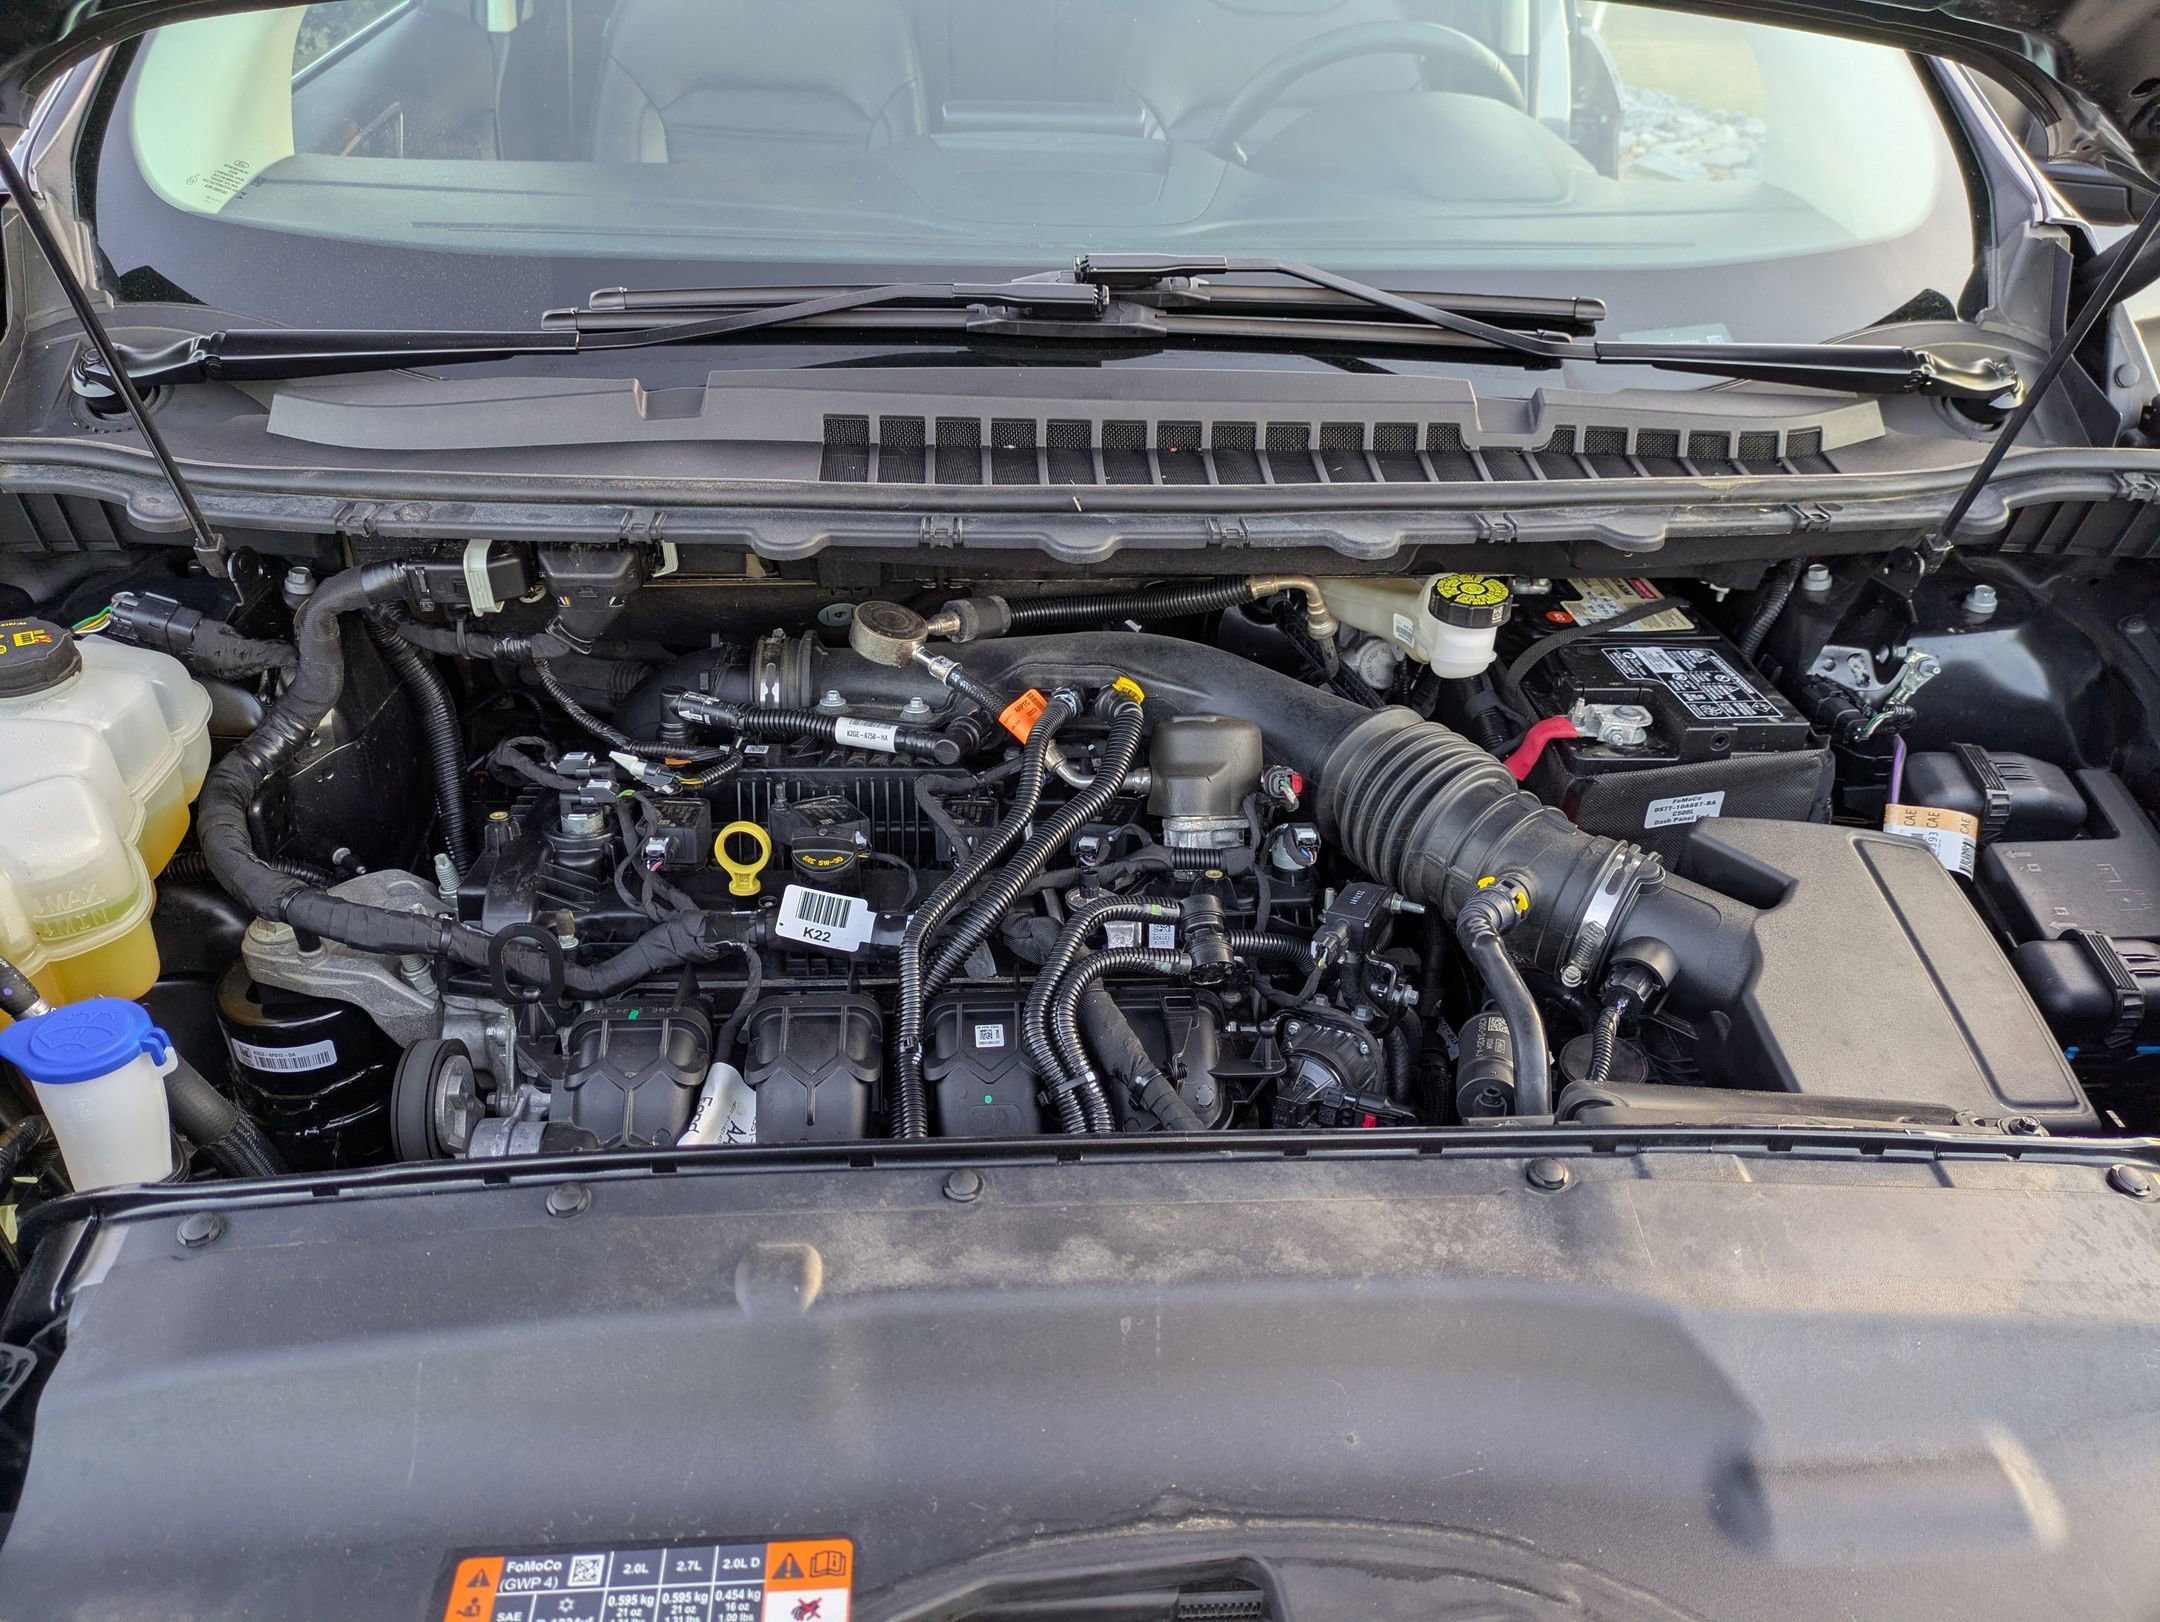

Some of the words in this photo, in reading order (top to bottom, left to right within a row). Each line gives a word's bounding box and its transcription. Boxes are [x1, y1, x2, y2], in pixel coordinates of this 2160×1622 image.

[1903, 808, 1917, 827] CAE
[1926, 811, 1940, 829] CAE
[1960, 817, 1971, 835] CAE
[802, 855, 816, 865] SAE
[818, 856, 844, 866] 5W-30
[803, 926, 831, 943] K22
[506, 1559, 562, 1573] FoMoCo
[622, 1563, 649, 1575] 2.0L
[676, 1560, 702, 1572] 2.7L
[722, 1558, 748, 1570] 2.0L
[750, 1557, 760, 1568] D
[499, 1577, 541, 1593] (GWP
[543, 1576, 559, 1590] 4)
[607, 1594, 638, 1607] 0.595
[640, 1593, 655, 1608] kg
[662, 1592, 692, 1604] 0.595
[694, 1591, 709, 1605] kg
[715, 1589, 745, 1602] 0.454
[748, 1588, 761, 1603] kg
[616, 1607, 628, 1618] 21
[629, 1608, 643, 1617] oz
[670, 1605, 682, 1615] 21
[684, 1605, 697, 1614] oz
[738, 1602, 750, 1611] oz
[496, 1612, 521, 1622] SAE
